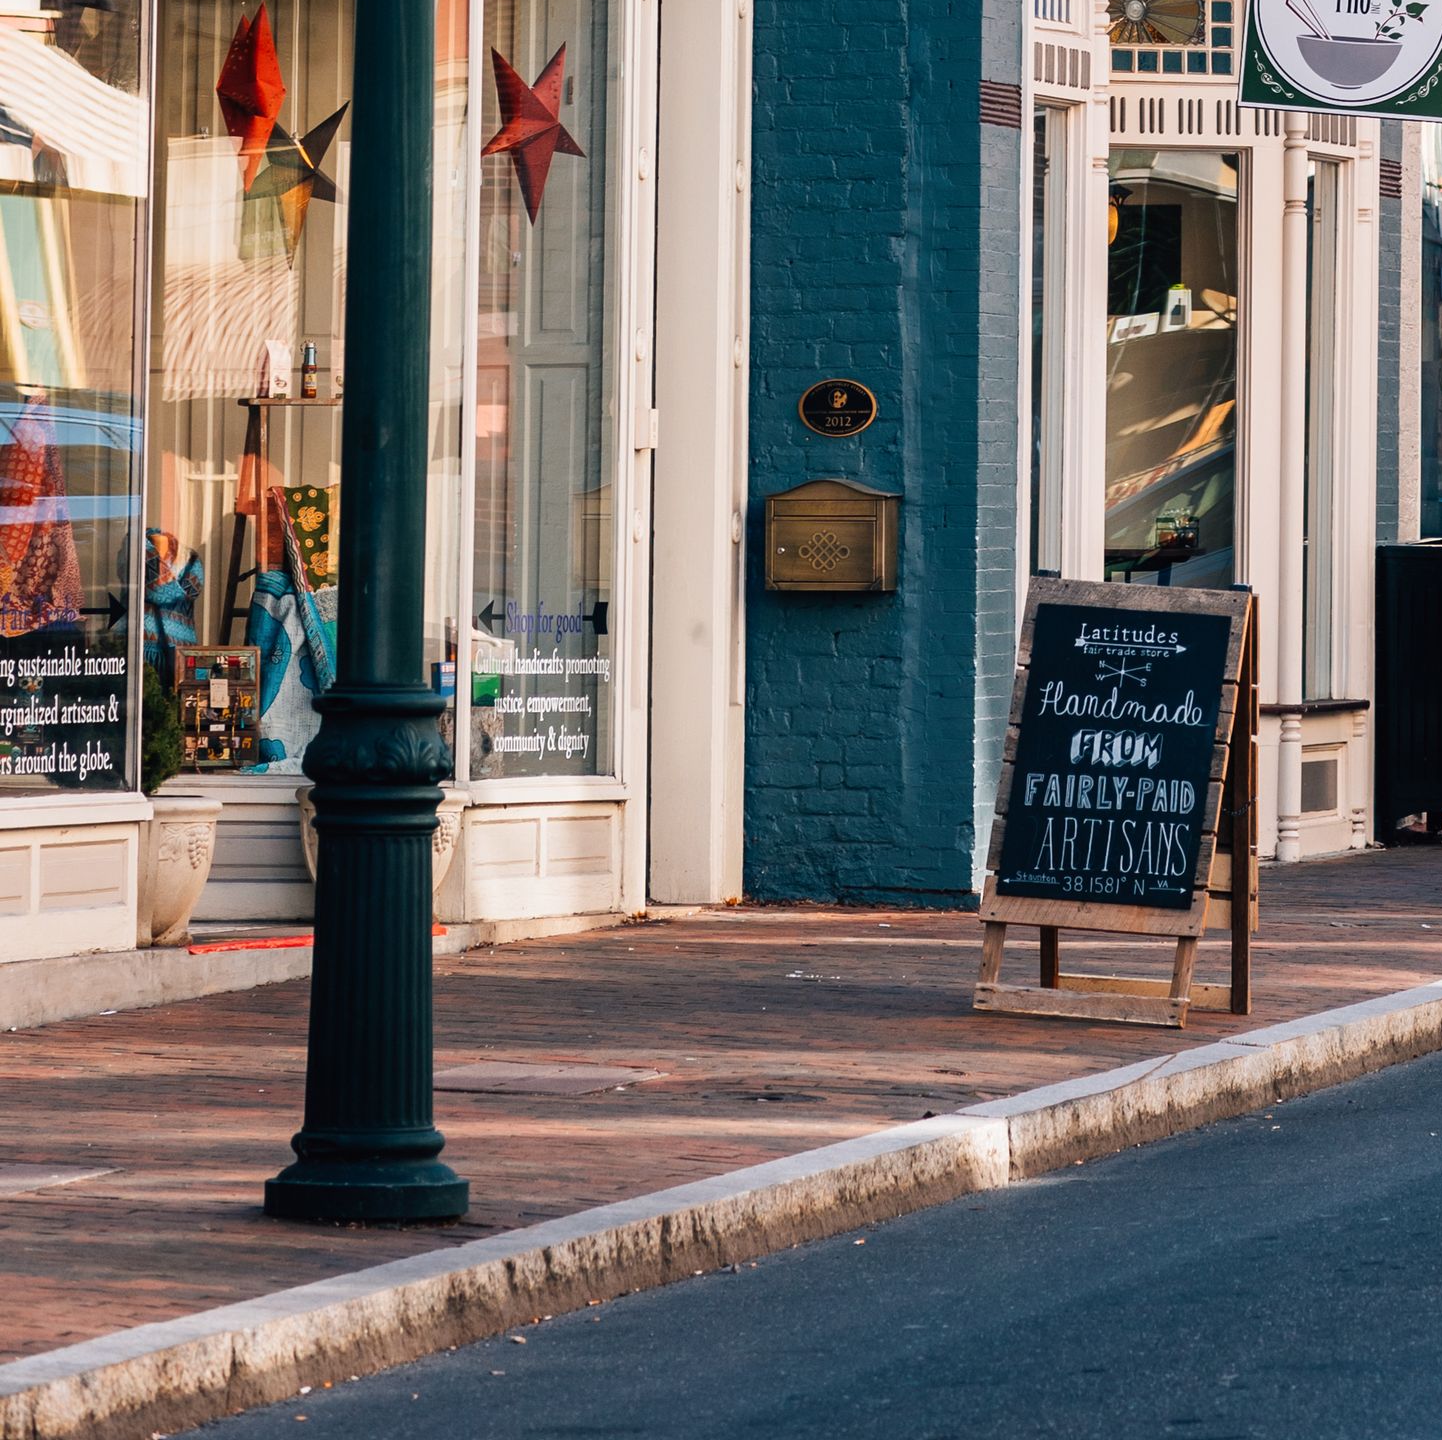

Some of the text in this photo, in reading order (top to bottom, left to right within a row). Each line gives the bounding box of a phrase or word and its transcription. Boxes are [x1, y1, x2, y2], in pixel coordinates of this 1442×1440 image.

[824, 416, 852, 428] 2012
[506, 600, 583, 644] Shop for good
[1080, 622, 1179, 644] Latitudes
[18, 646, 81, 677] sustainable
[84, 649, 126, 676] income
[475, 647, 513, 676] Cultural
[514, 647, 564, 675] handicrafts
[565, 651, 611, 683] promoting
[1083, 644, 1170, 658] fair trade store
[0, 693, 120, 736] rginalized artisans &
[493, 688, 592, 722] justice, empowerment,
[1038, 680, 1210, 728] Handmade
[15, 742, 56, 774] around
[58, 742, 77, 773] the
[79, 740, 114, 781] globe.
[493, 724, 590, 761] community & dignity
[1069, 728, 1164, 770] FROM
[1023, 772, 1196, 815] FAIRLY-PAID
[1033, 816, 1190, 877] ARTISANS
[1015, 871, 1057, 884] Staunton
[1133, 879, 1146, 896] N
[1156, 879, 1169, 889] VA
